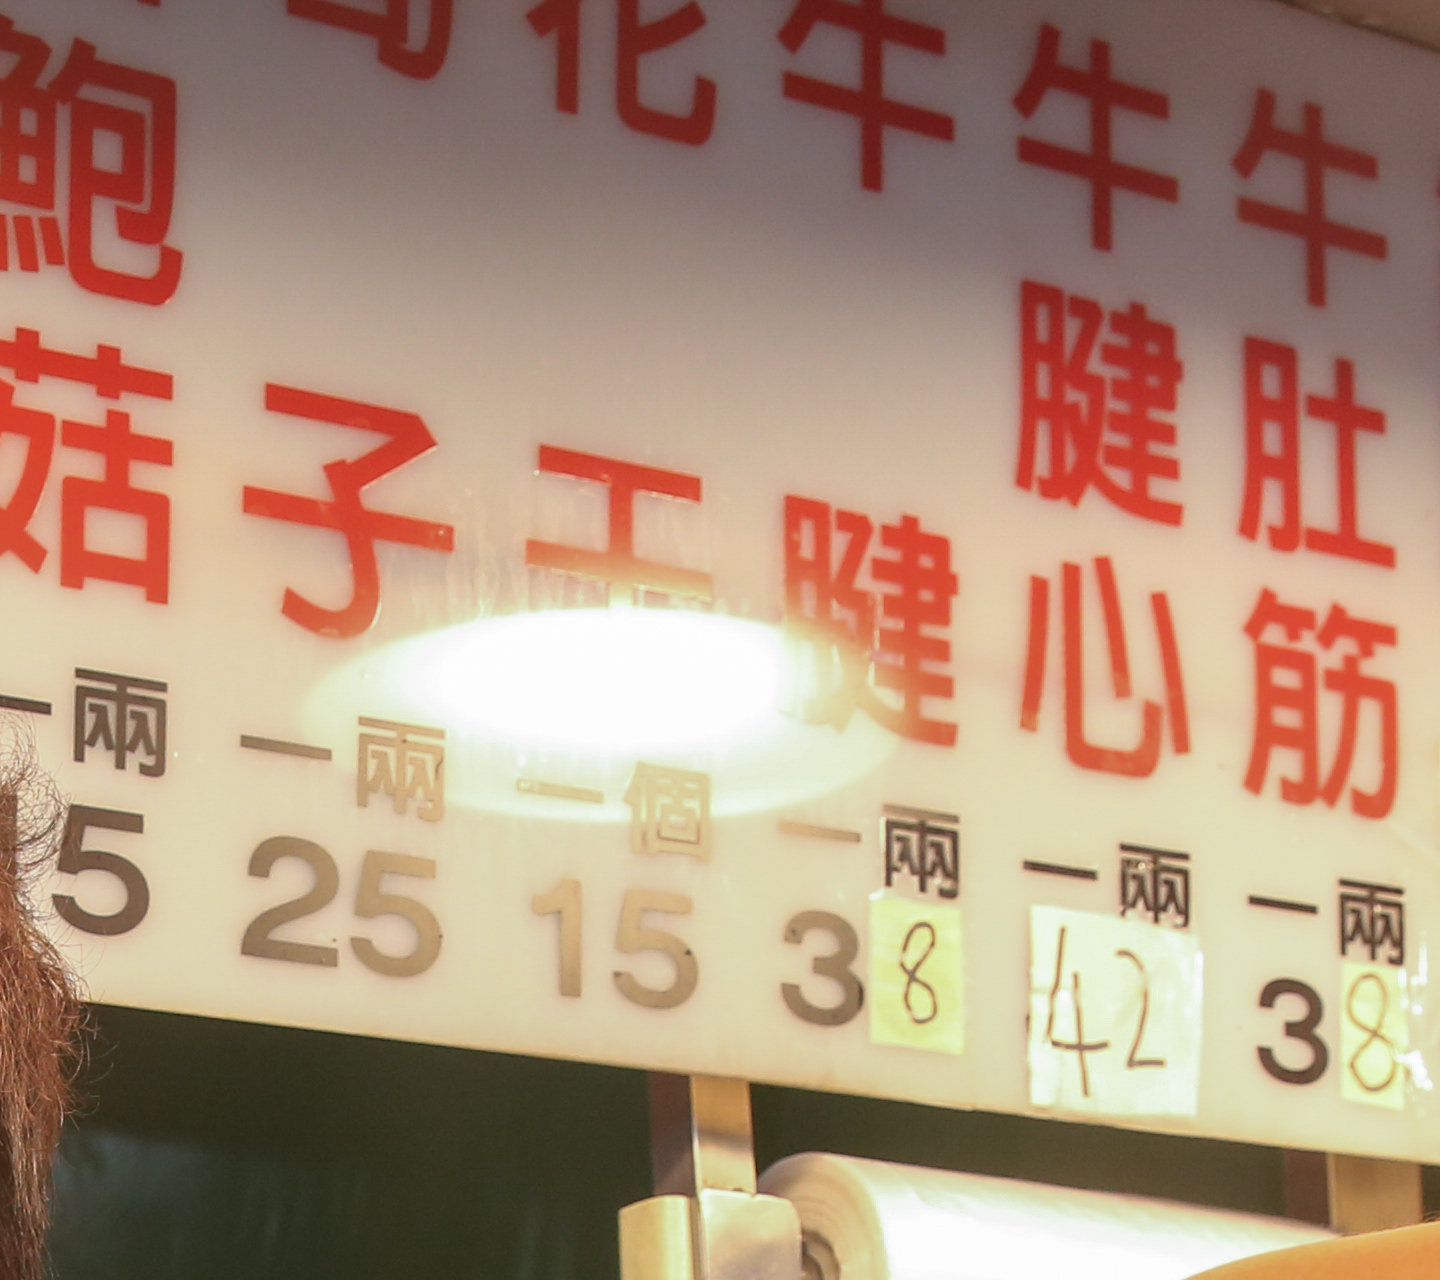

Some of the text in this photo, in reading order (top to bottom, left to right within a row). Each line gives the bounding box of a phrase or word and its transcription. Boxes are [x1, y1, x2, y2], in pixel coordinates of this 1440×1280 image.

[240, 715, 446, 821] 一兩
[516, 761, 712, 861] 一個
[0, 793, 151, 936] 5
[777, 804, 960, 899] 一兩
[1023, 843, 1190, 929] 一兩
[240, 835, 443, 977] 25
[531, 878, 700, 1009] 15
[1248, 877, 1405, 966] 一兩
[1046, 926, 1167, 1097] 42
